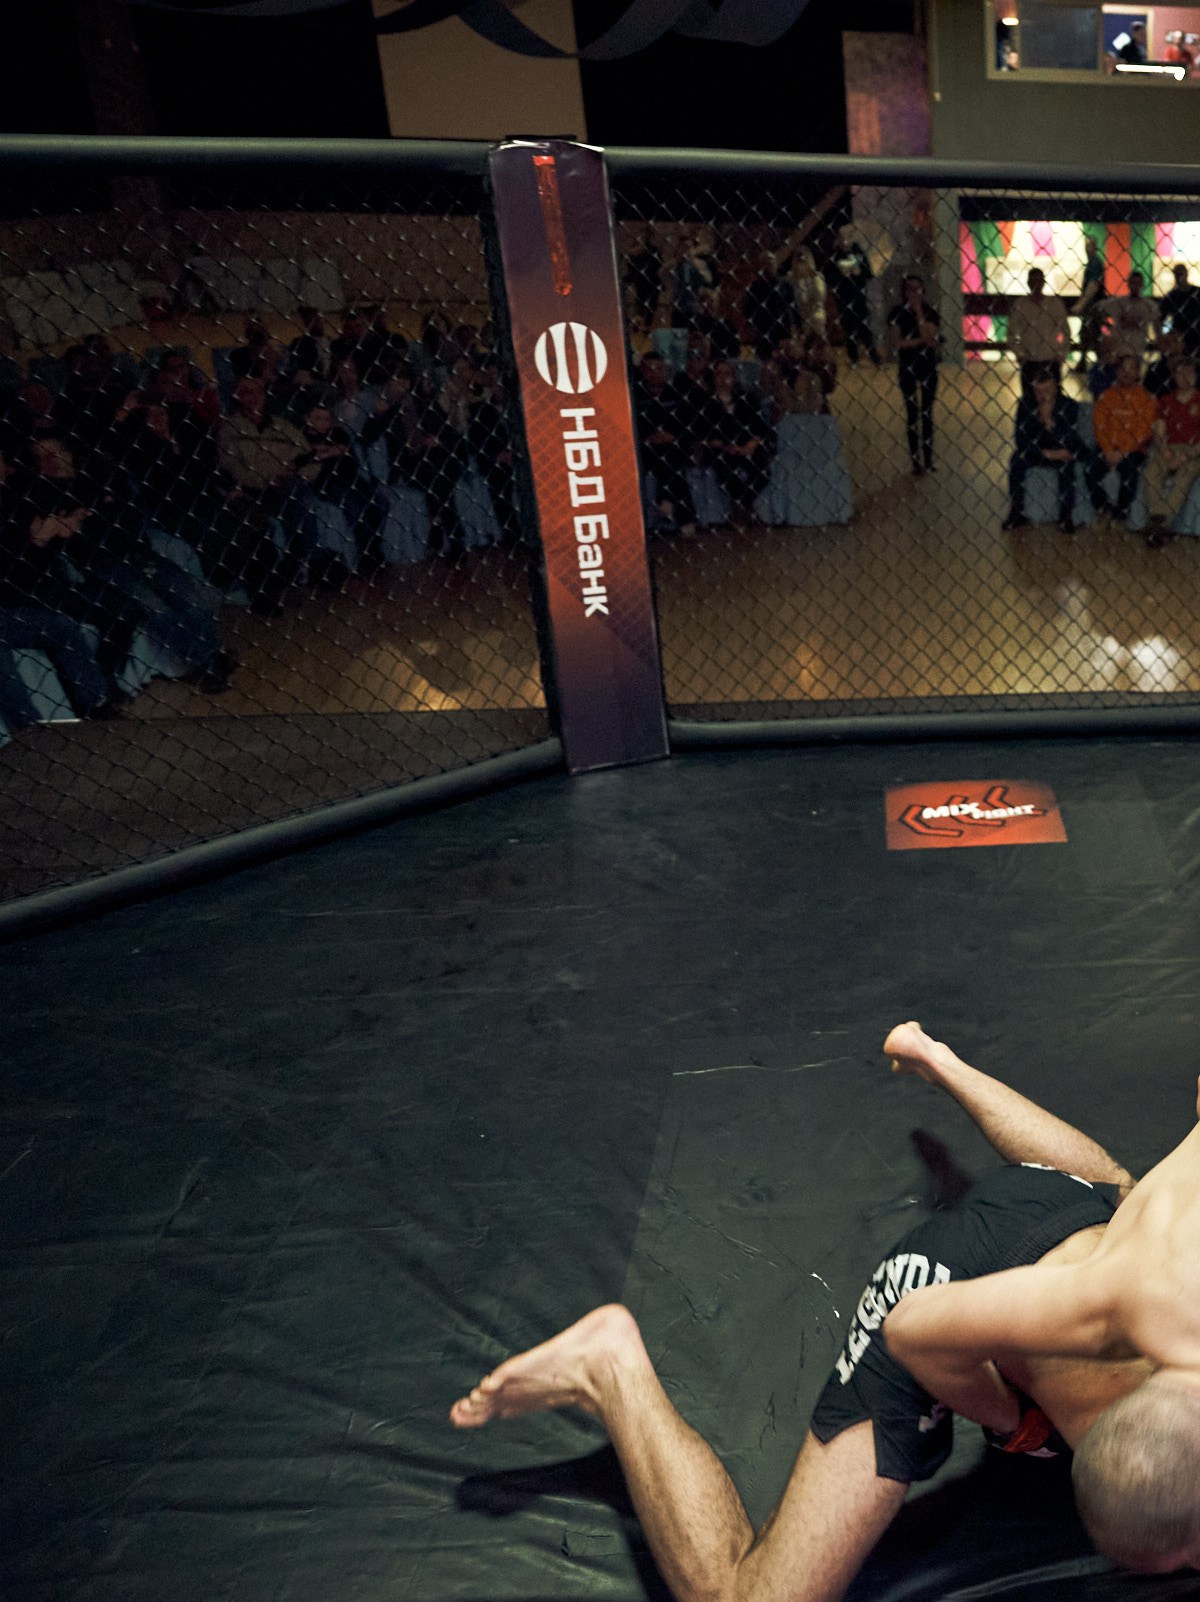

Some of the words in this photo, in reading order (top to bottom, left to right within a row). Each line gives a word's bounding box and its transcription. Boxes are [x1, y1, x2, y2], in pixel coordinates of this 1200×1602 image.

[560, 407, 606, 508] НБД
[573, 513, 610, 618] Банк
[921, 802, 980, 820] MIX
